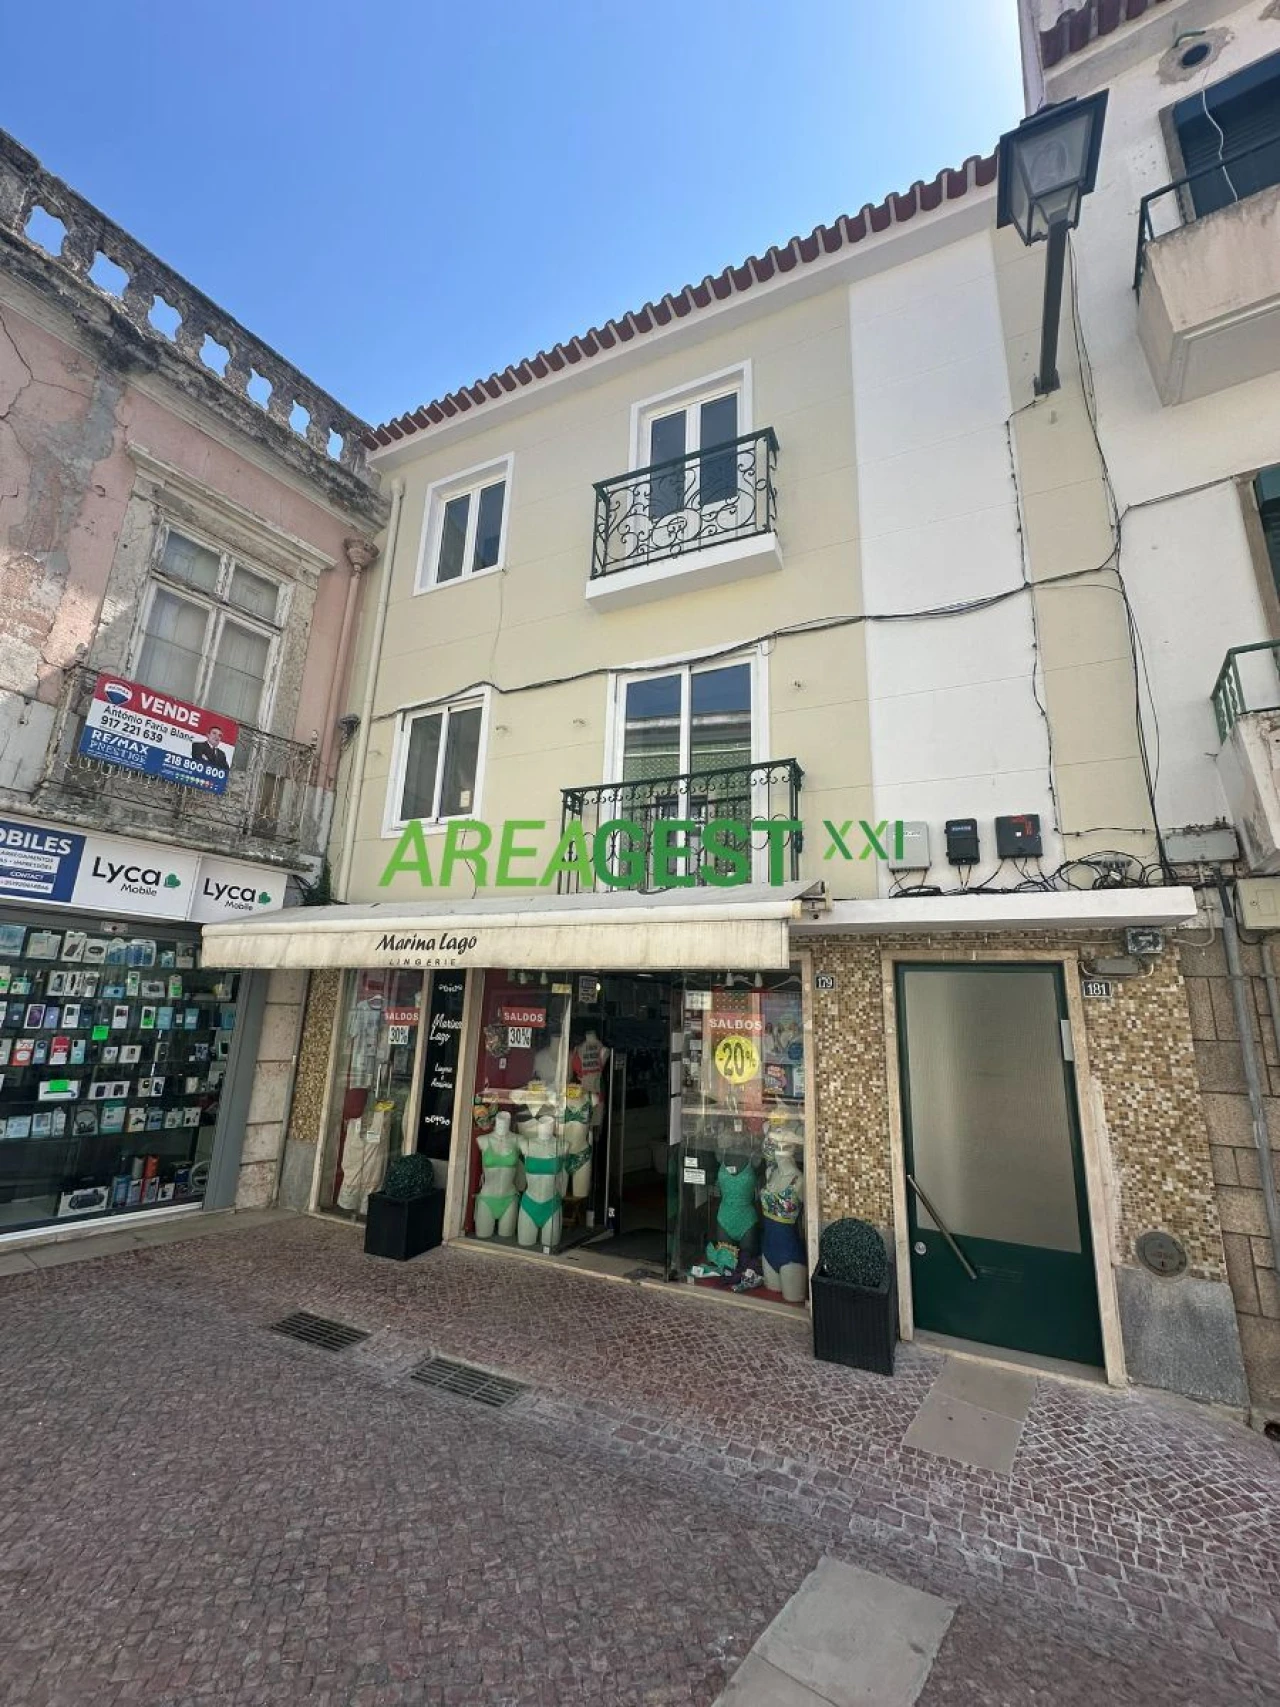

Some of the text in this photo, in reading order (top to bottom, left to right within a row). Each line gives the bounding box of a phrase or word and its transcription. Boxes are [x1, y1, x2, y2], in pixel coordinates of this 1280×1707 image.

[140, 692, 201, 727] VENDE
[103, 705, 143, 725] António
[145, 719, 167, 734] Faria
[100, 714, 163, 743] 917 221 639
[91, 729, 149, 755] RE/MAX
[89, 740, 148, 764] PRESTIGE
[164, 753, 181, 766] 218
[183, 758, 204, 773] 800
[205, 767, 225, 779] 800
[91, 855, 162, 886] Lyca
[120, 883, 157, 897] Mobile
[203, 877, 257, 902] Lyca
[224, 900, 254, 911] Mobile
[375, 932, 477, 955] Marina Lago
[389, 958, 456, 967] LINGERIE
[817, 977, 833, 988] 179
[1087, 984, 1108, 996] 181
[384, 1011, 419, 1021] SALDOS
[503, 1012, 544, 1022] SALDOS
[709, 1019, 762, 1031] SALDOS
[389, 1027, 408, 1044] 30%
[510, 1028, 530, 1045] 30%
